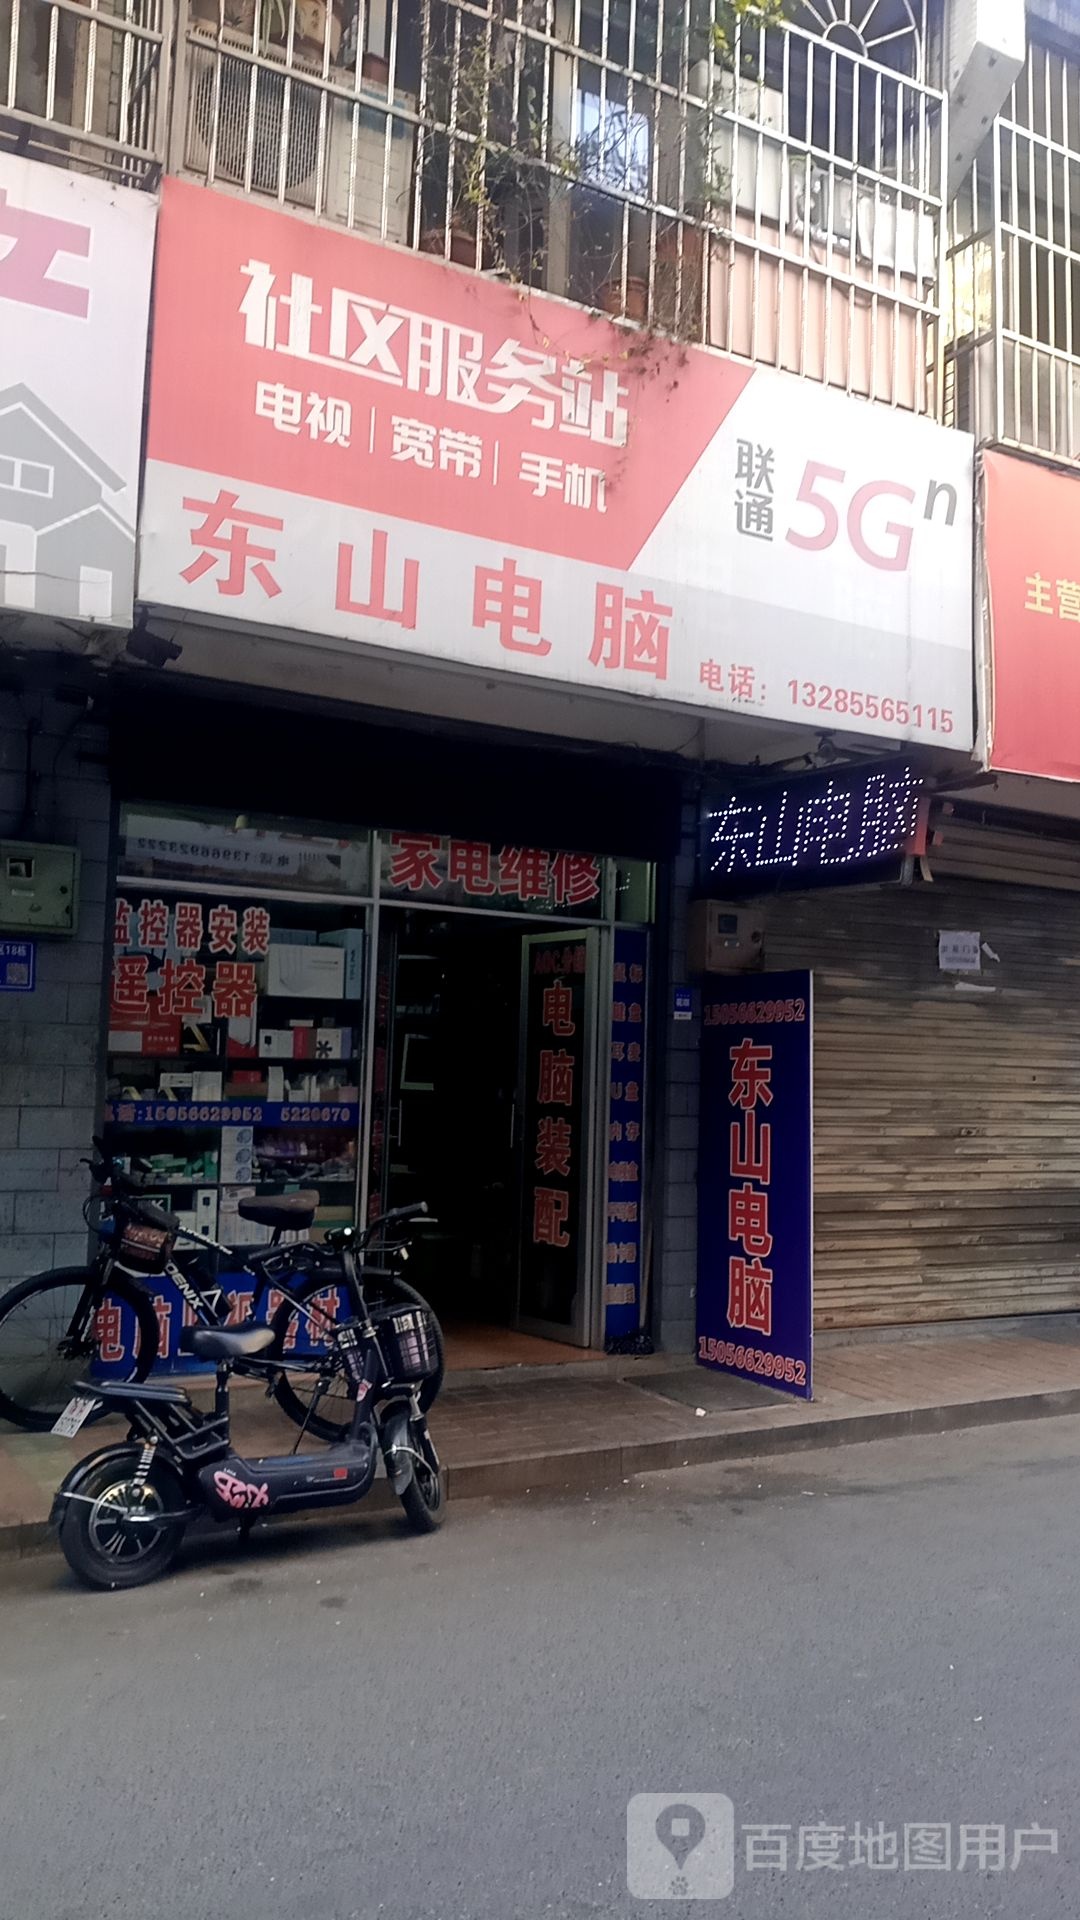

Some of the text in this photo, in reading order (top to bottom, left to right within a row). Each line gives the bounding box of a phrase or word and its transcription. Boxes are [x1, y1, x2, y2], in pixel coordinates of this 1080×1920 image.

[238, 259, 629, 448] 社区服务站
[255, 380, 608, 514] 电视 宽带 手机
[735, 438, 776, 543] 联通
[179, 490, 674, 680] 东山电脑
[787, 679, 954, 735] 13285565115
[388, 832, 601, 906] 家电维修
[707, 766, 925, 873] 东山电脑
[111, 954, 258, 1018] 遥控器
[703, 997, 806, 1026] 15056629952
[533, 979, 576, 1248] 电脑装配
[726, 1037, 774, 1337] 东山电脑
[698, 1336, 807, 1386] 15056629952
